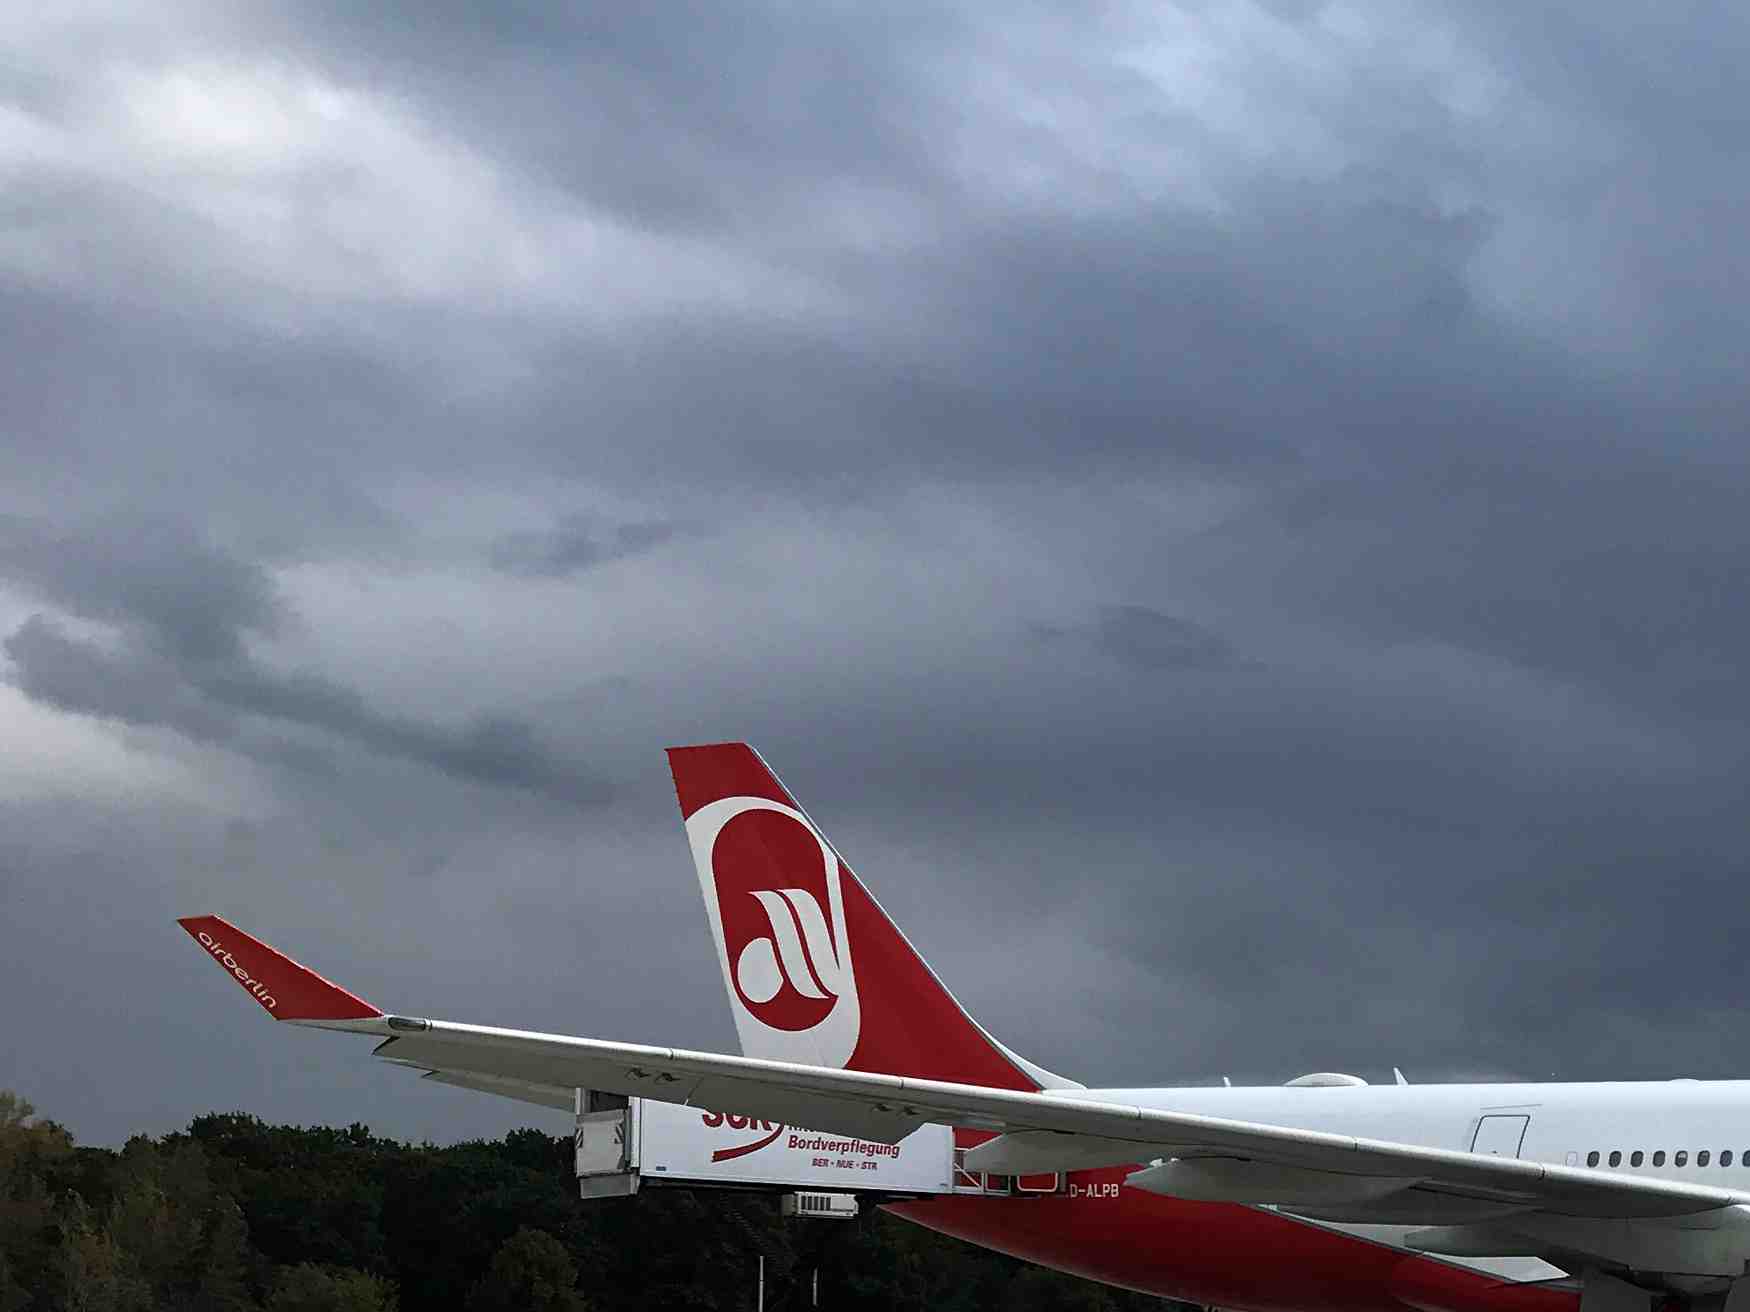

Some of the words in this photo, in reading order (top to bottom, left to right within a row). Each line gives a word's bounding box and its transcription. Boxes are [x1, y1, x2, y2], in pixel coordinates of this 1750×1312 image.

[198, 931, 278, 1009] airberlin
[788, 1134, 900, 1159] Bordverpflegung
[1070, 1183, 1120, 1198] D-ALPB
